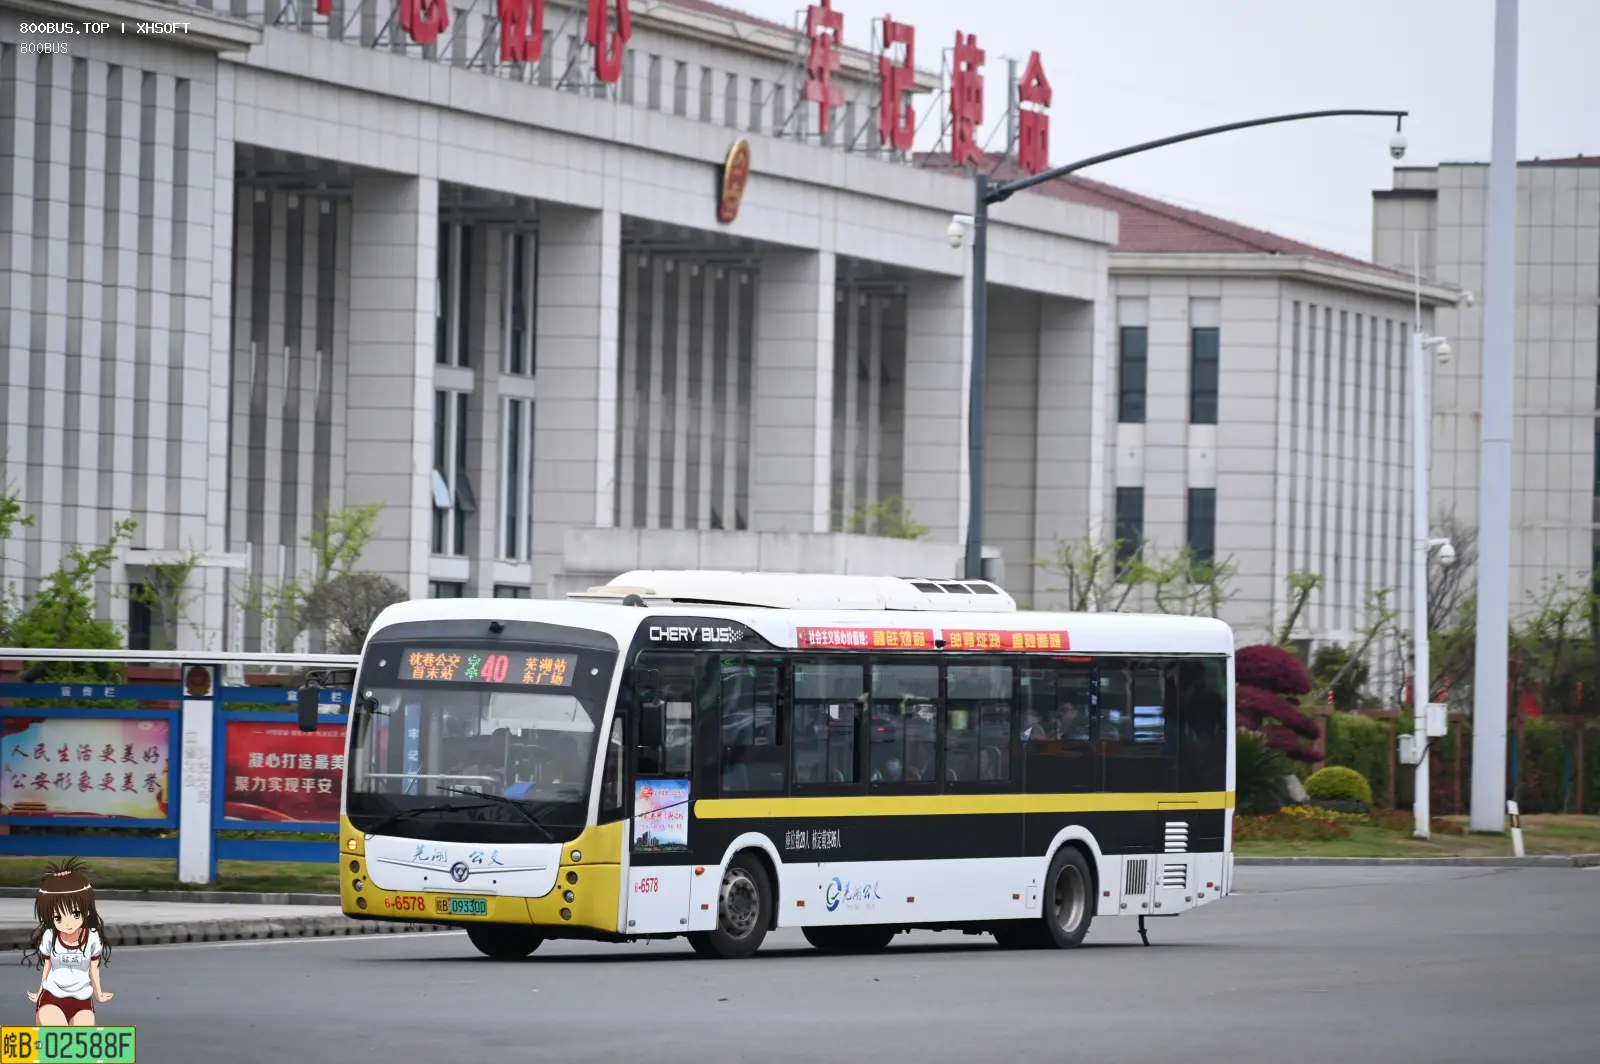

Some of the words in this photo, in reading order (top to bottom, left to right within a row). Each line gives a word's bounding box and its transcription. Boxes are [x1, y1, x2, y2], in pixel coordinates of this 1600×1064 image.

[804, 0, 1053, 174] 牢记使命
[649, 626, 698, 642] CHERY
[701, 627, 729, 642] BUS
[409, 652, 461, 668] 沈巷公交
[480, 654, 509, 682] 40
[524, 657, 567, 673] 芜湖站
[412, 665, 454, 680] 首末站
[522, 671, 564, 685] 东广场
[10, 743, 161, 765] 人民生活更美好
[247, 752, 345, 770] 凝心打造最美
[10, 770, 162, 793] 公安形象更美誉
[234, 776, 333, 794] 聚力实现平安
[468, 849, 504, 866] 公交
[634, 877, 659, 893] 6-6578
[384, 896, 426, 912] 6-6578
